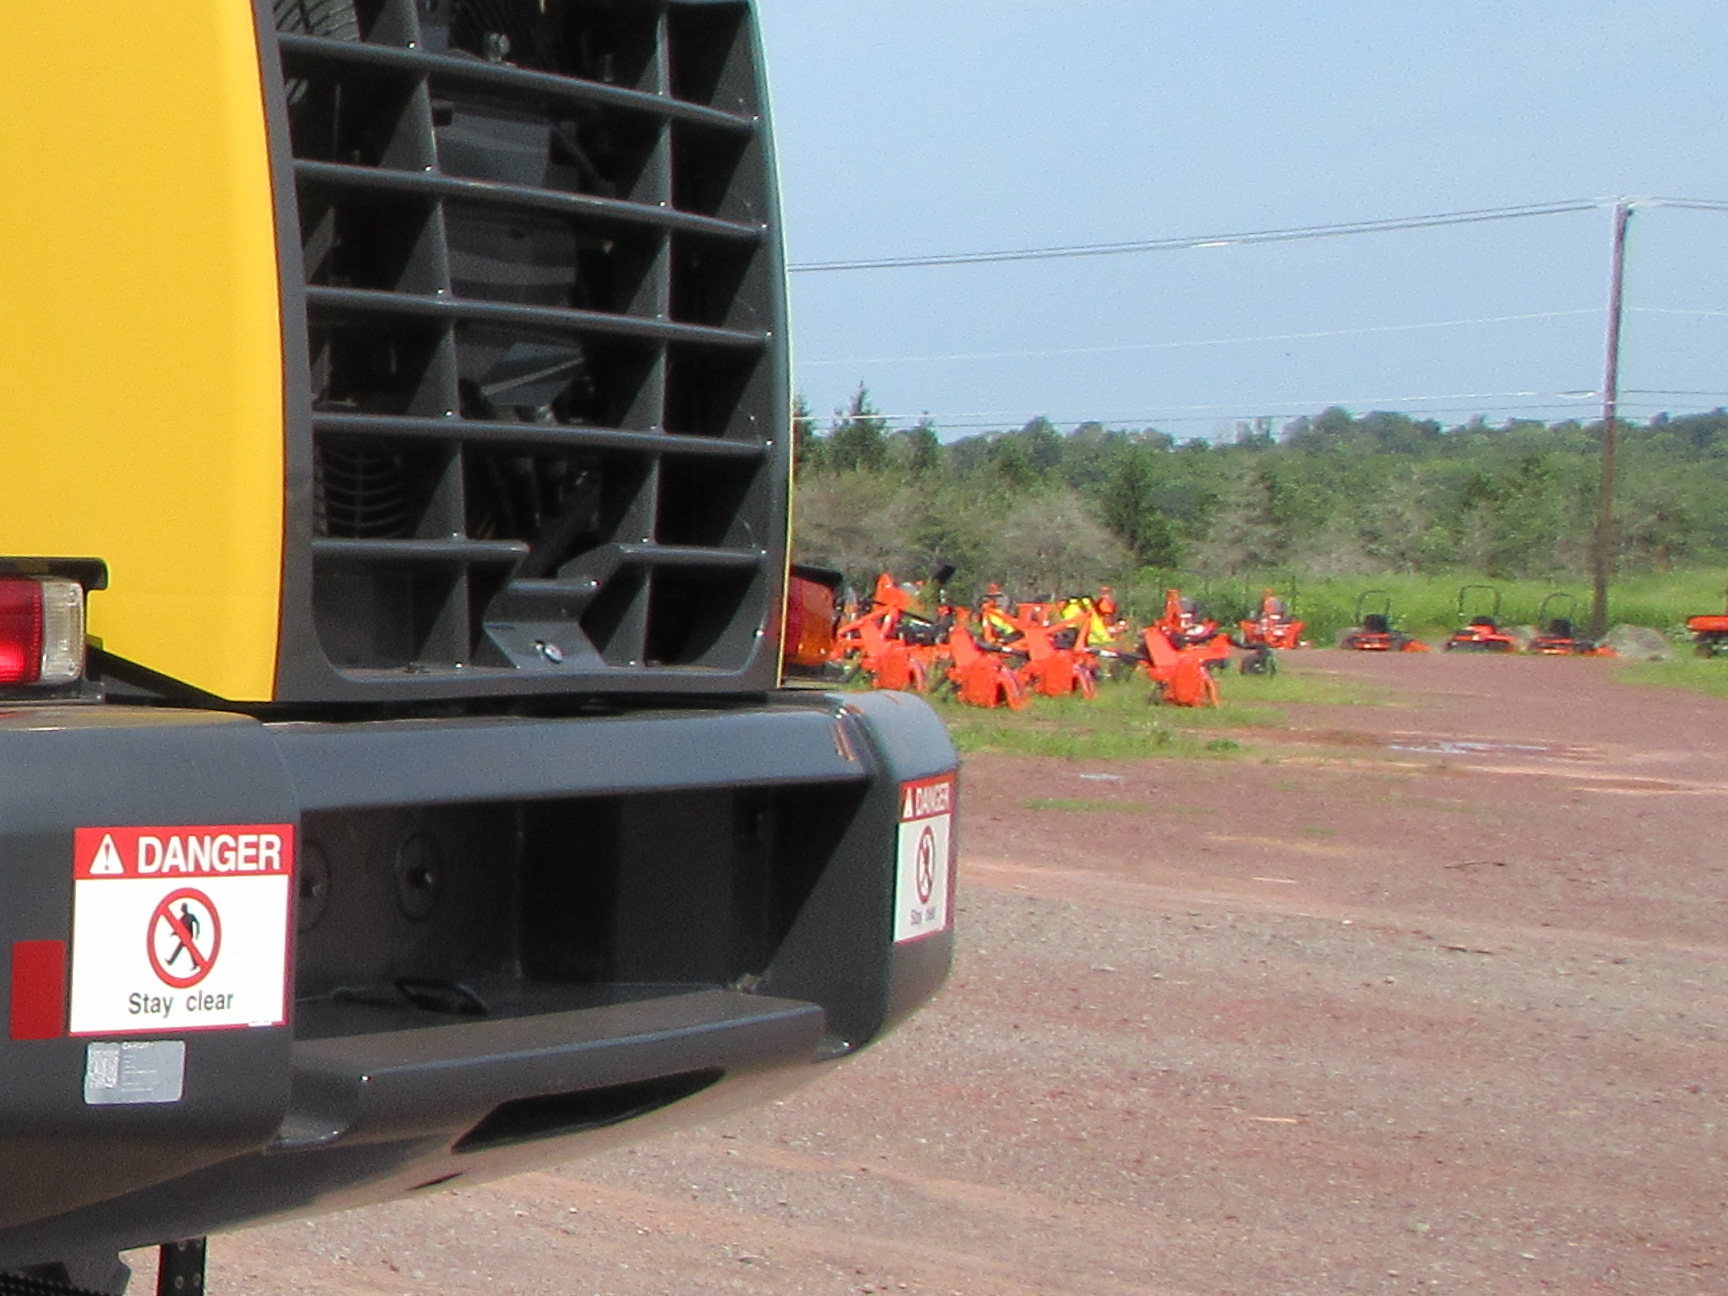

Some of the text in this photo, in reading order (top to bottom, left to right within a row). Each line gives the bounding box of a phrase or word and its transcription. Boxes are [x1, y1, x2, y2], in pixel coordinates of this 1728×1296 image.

[137, 834, 282, 874] DANGER
[128, 990, 234, 1019] Stay clear
